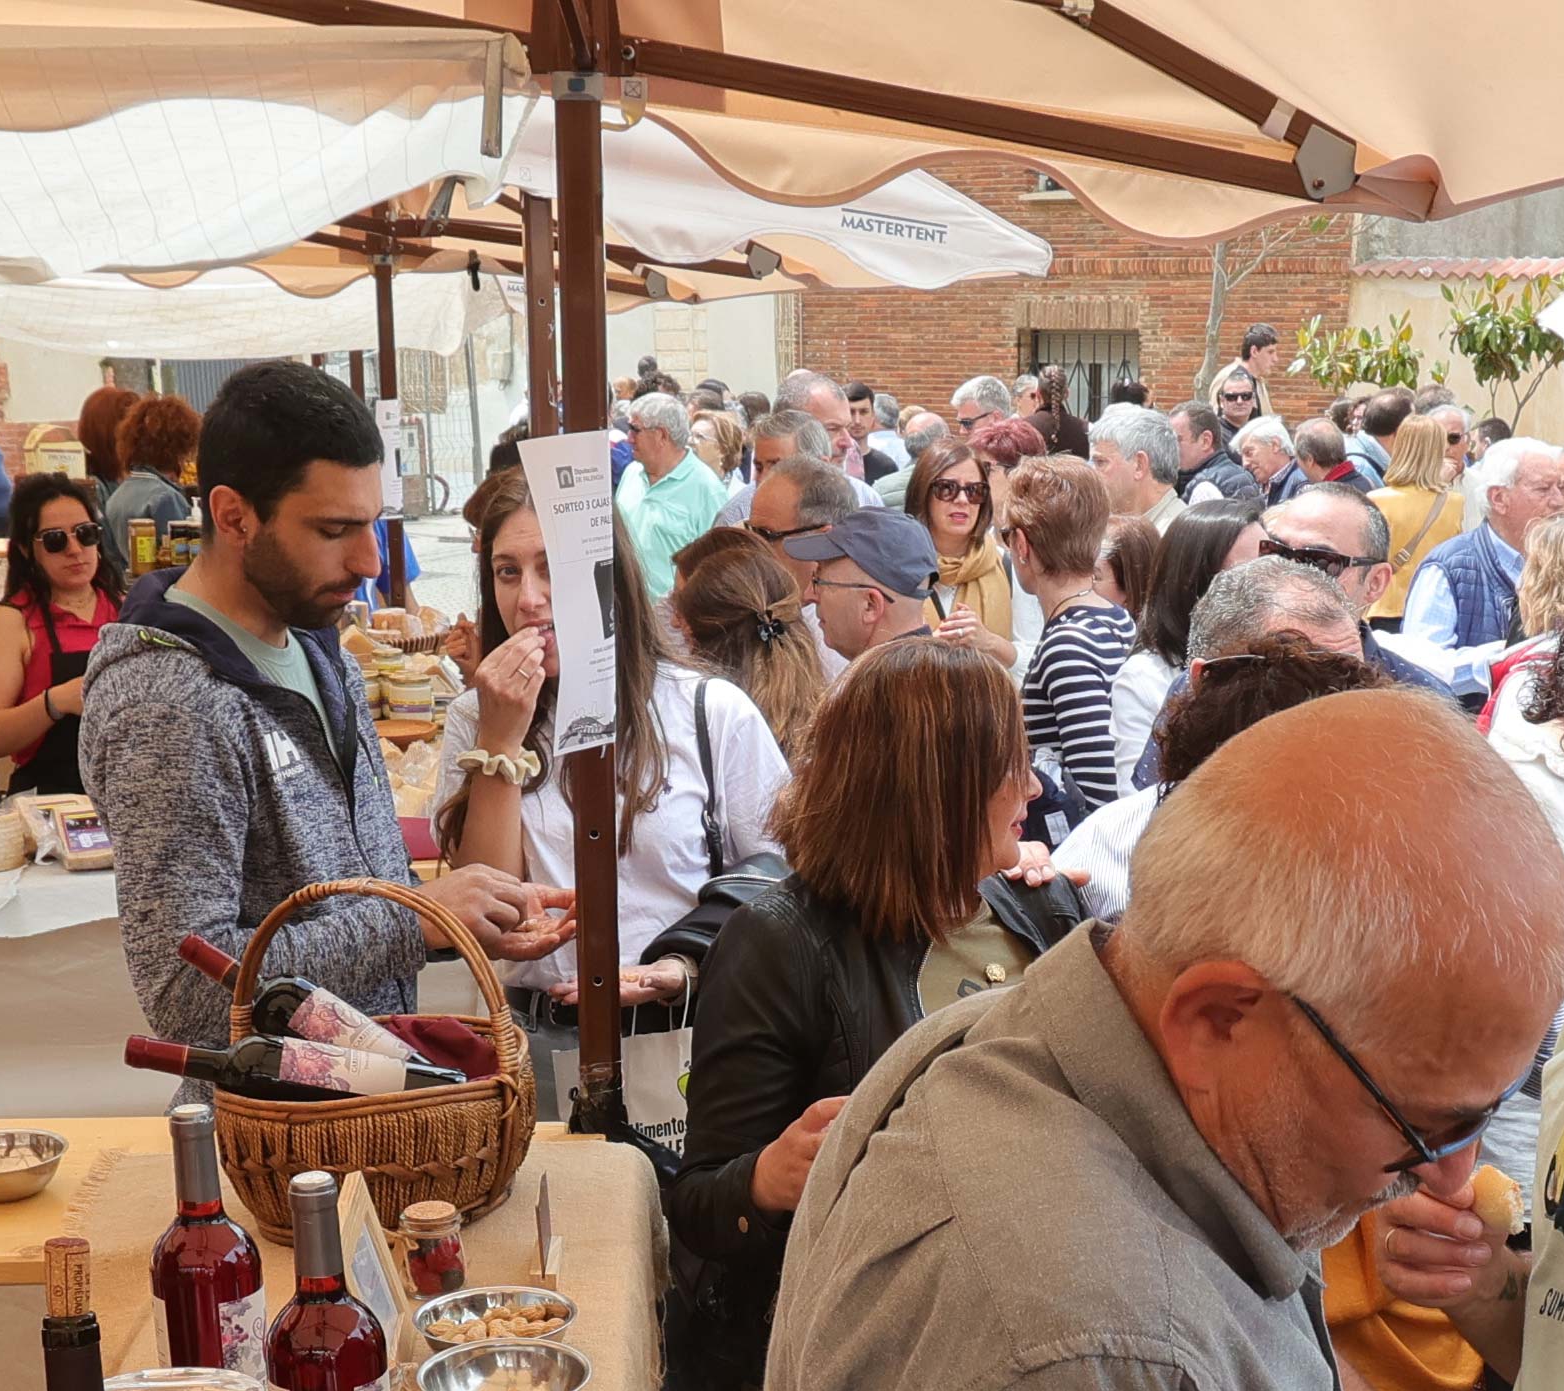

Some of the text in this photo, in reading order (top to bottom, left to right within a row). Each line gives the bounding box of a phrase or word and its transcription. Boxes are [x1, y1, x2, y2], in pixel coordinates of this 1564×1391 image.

[841, 214, 947, 244] MASTERTENT
[553, 500, 584, 514] SORTEO
[586, 499, 590, 509] 3
[590, 517, 599, 527] DE
